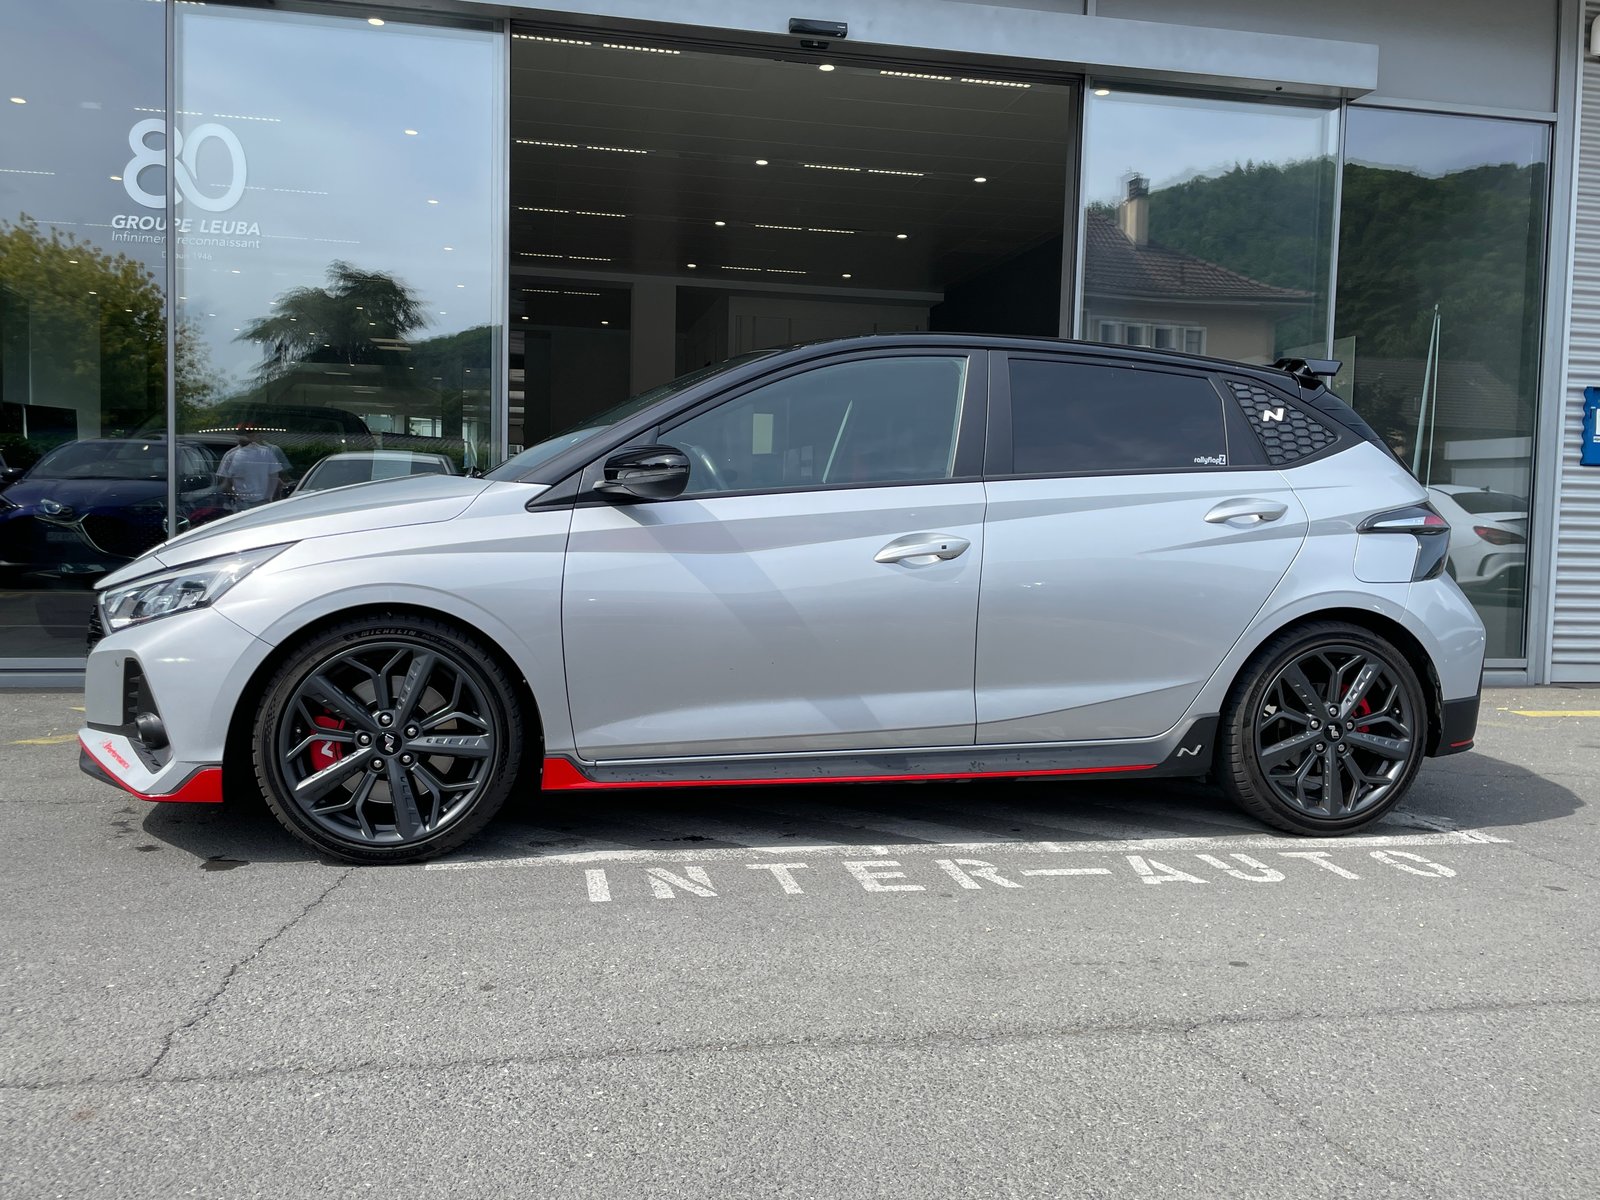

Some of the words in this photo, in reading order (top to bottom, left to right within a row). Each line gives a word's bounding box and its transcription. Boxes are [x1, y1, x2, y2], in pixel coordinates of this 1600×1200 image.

[123, 118, 247, 212] 80
[200, 219, 261, 236] LEUBA
[112, 231, 167, 244] Infinimen
[177, 236, 260, 249] reconnaissant
[1262, 408, 1285, 422] N
[360, 628, 417, 637] MICHELIN
[1176, 744, 1202, 757] N
